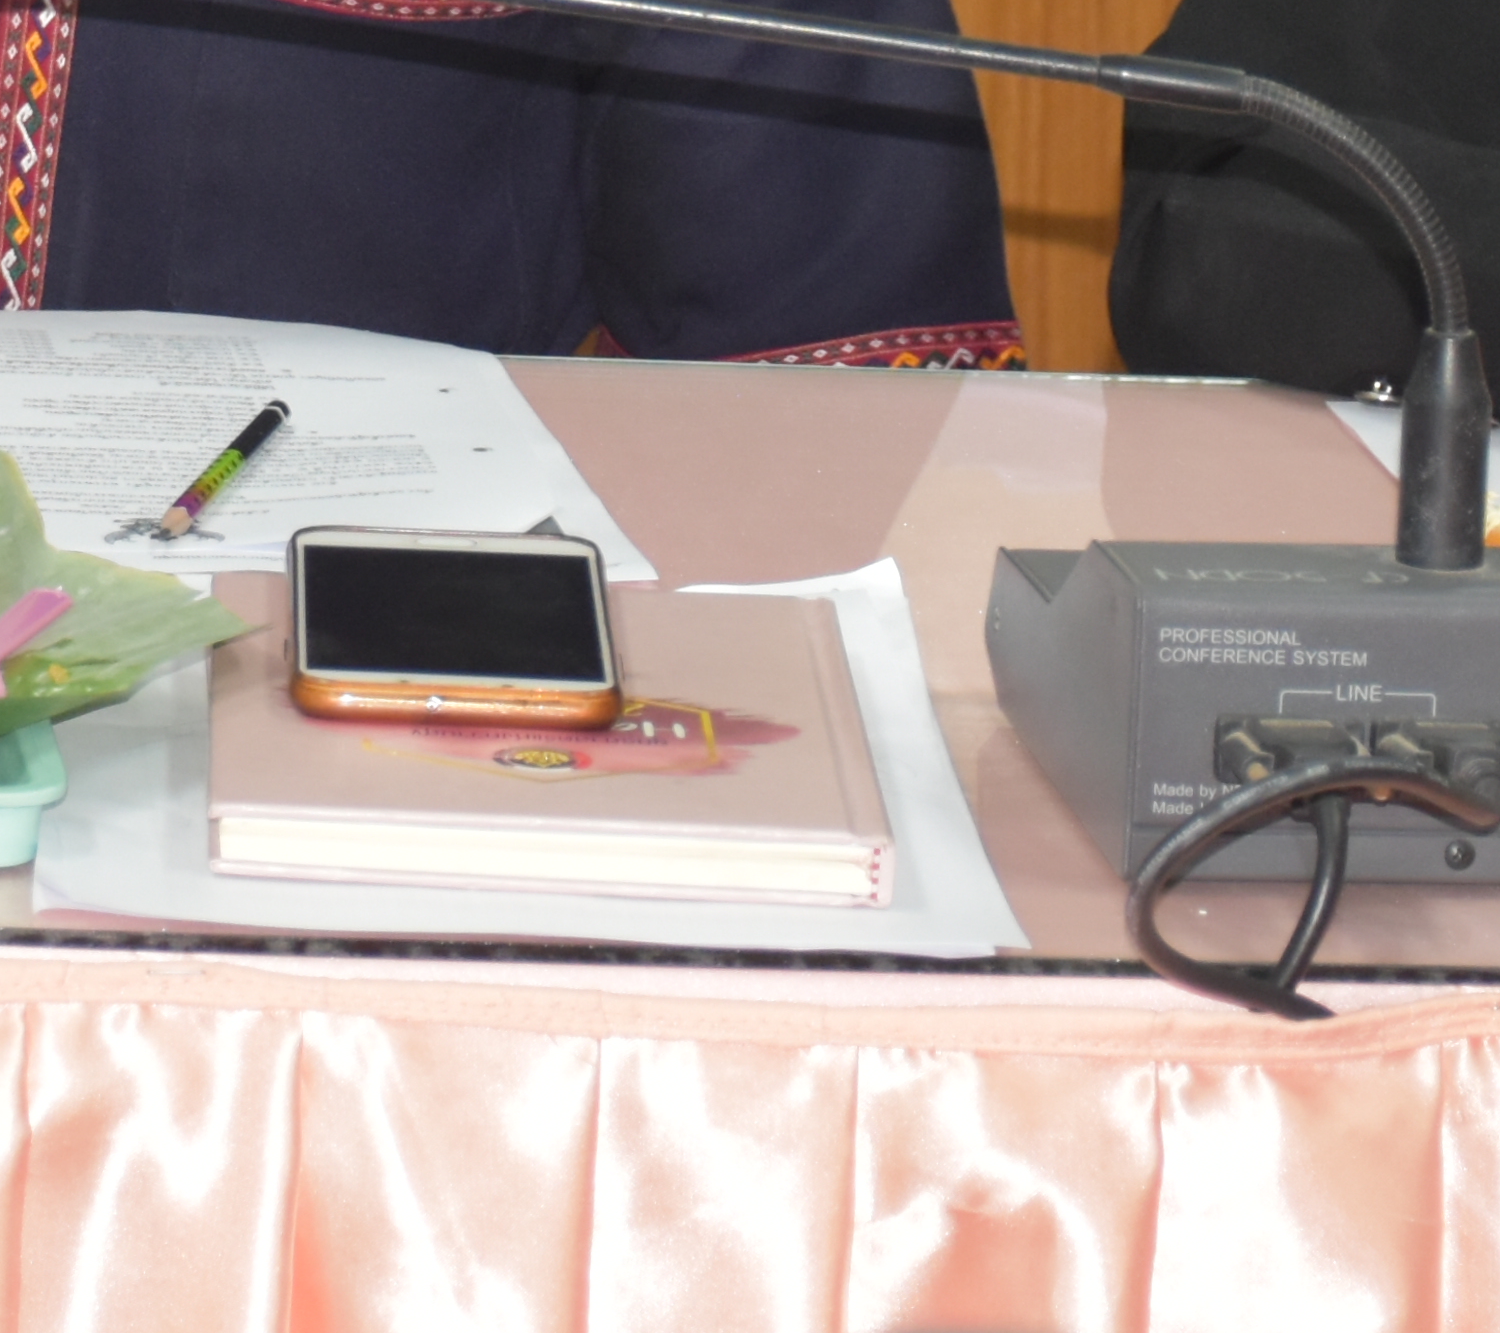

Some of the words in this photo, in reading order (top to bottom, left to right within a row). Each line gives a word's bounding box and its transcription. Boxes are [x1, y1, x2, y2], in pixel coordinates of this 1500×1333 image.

[1159, 627, 1301, 646] PROFESSIONAL
[1158, 647, 1286, 665] CONFERENCE
[1293, 650, 1368, 667] SYSTEM
[1336, 684, 1382, 702] LINE
[1153, 782, 1194, 798] Made
[1200, 783, 1217, 799] by
[1152, 800, 1194, 815] Made
